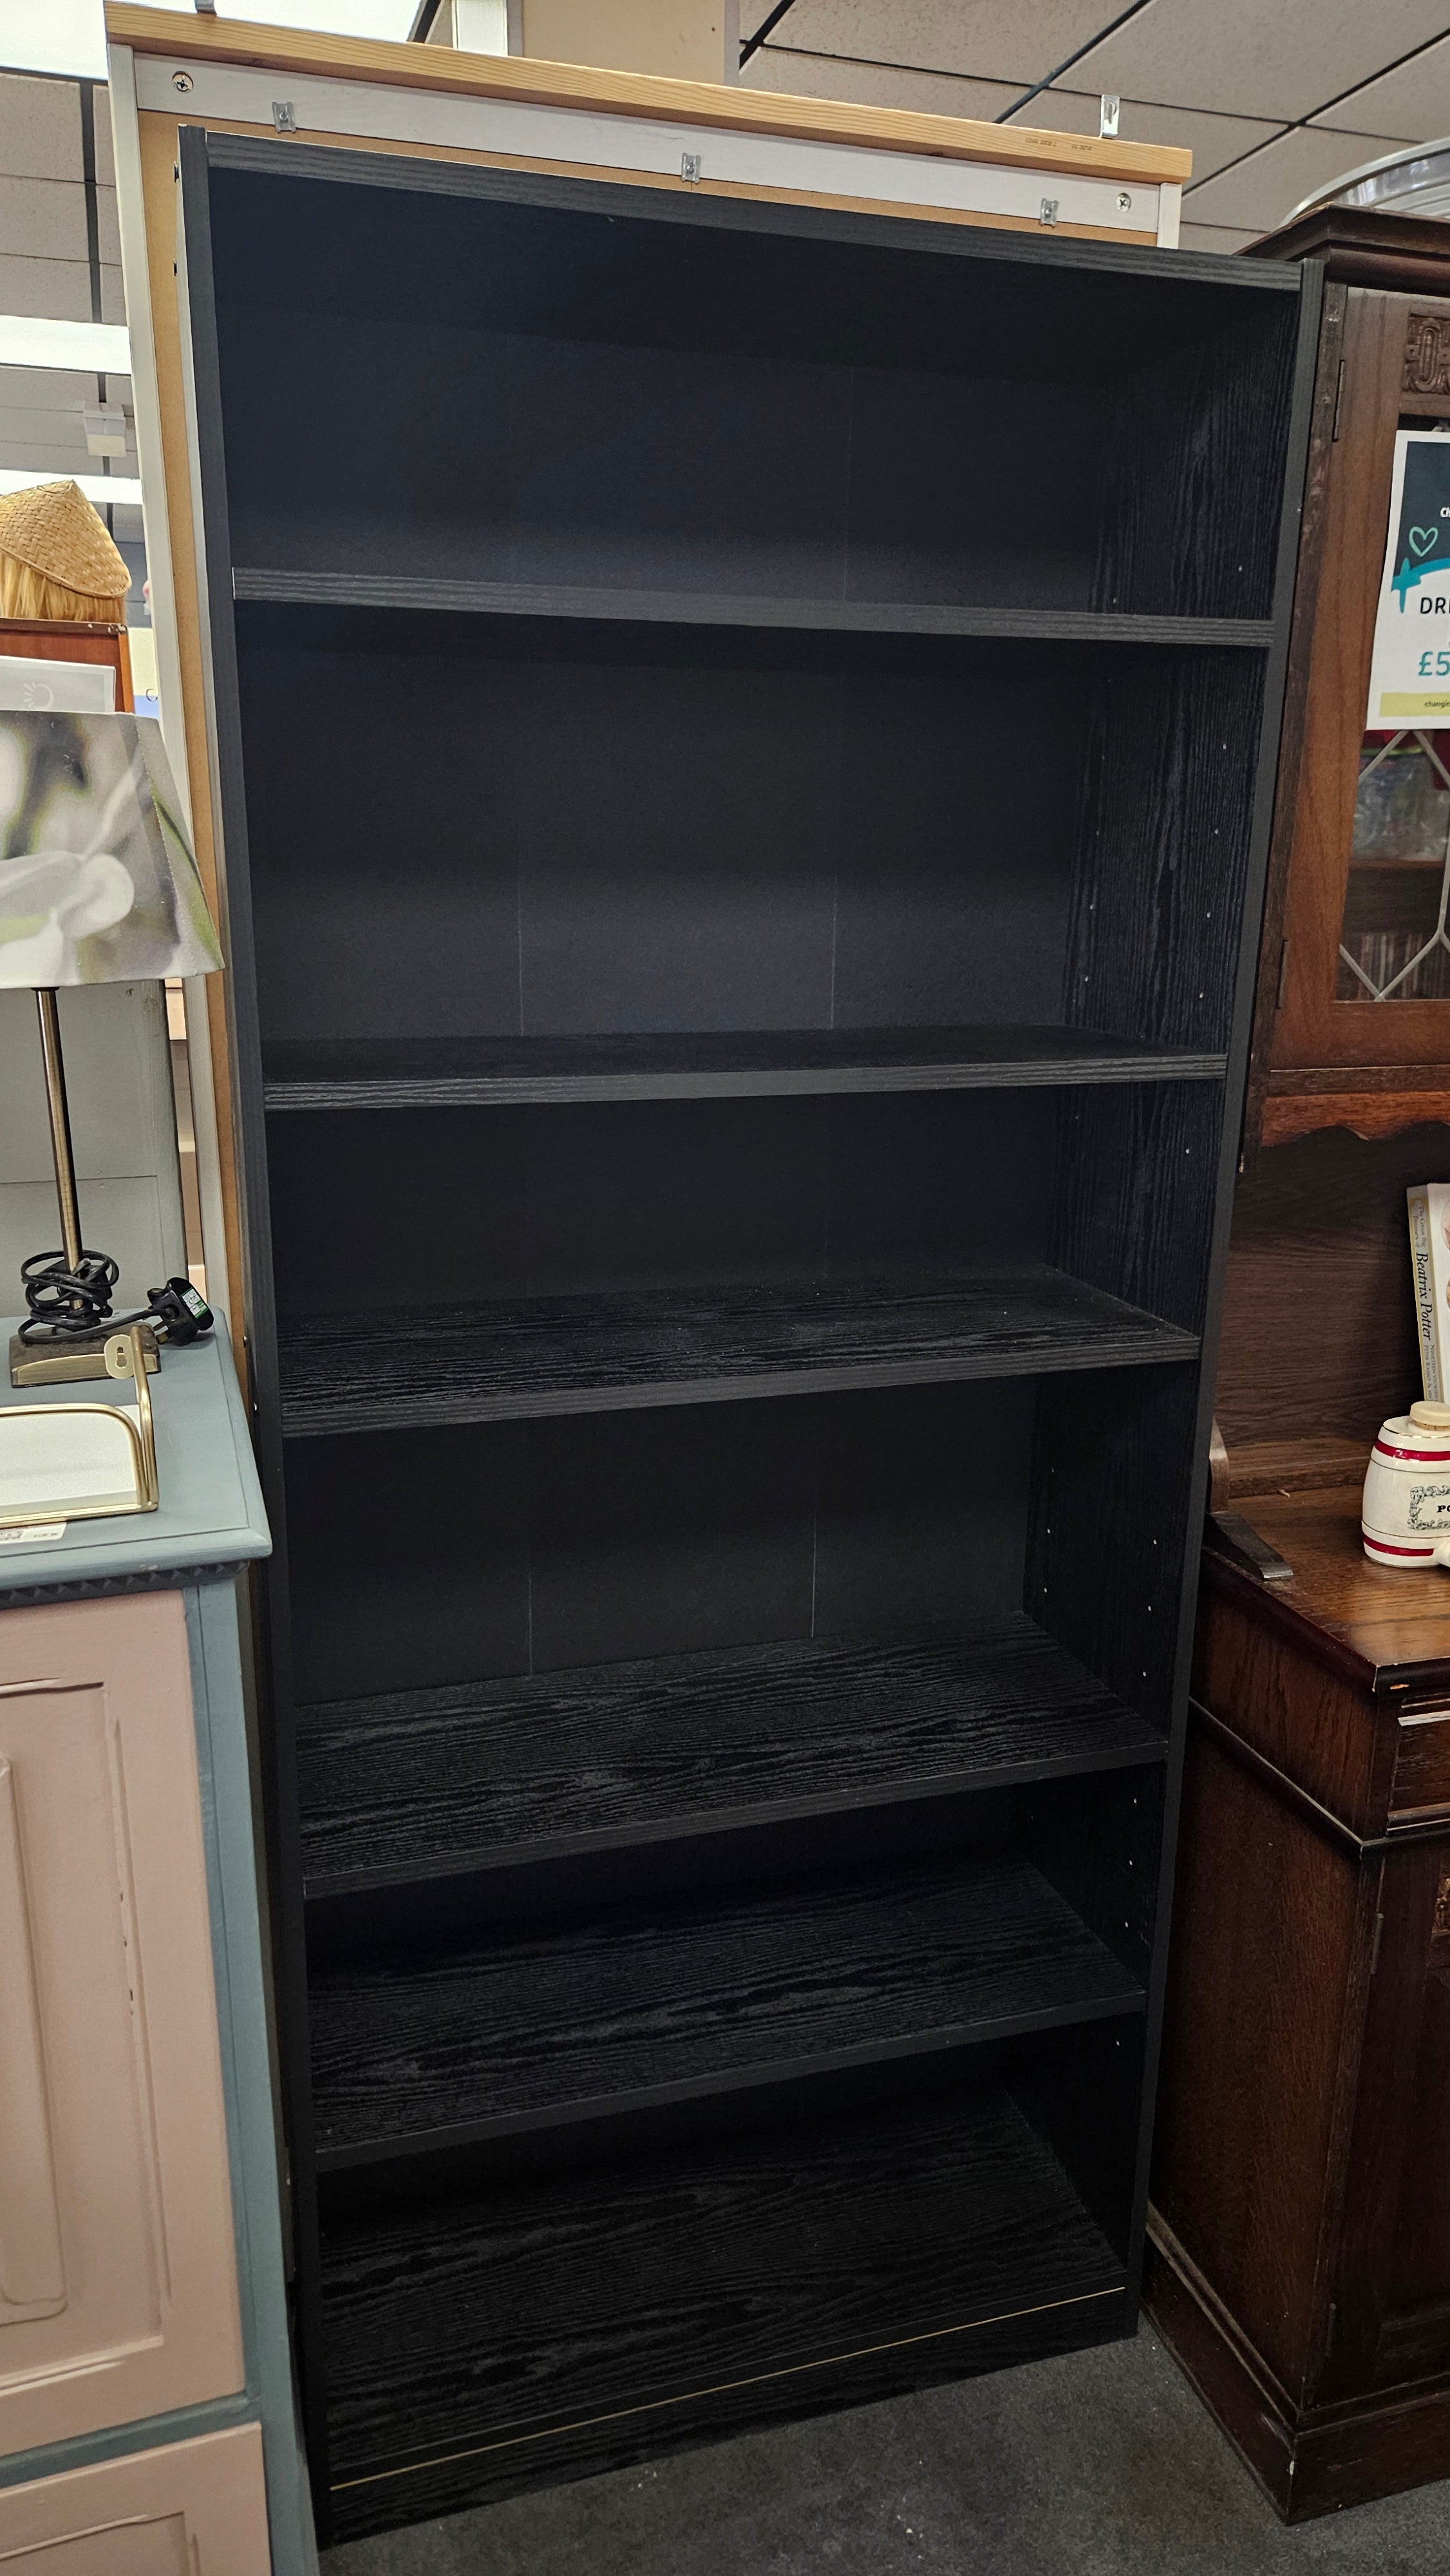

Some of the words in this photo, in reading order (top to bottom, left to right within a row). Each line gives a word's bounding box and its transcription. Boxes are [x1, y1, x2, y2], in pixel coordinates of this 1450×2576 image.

[1420, 596, 1450, 614] DR
[1416, 1252, 1431, 1299] Beatrix
[1420, 1302, 1433, 1341] Potter
